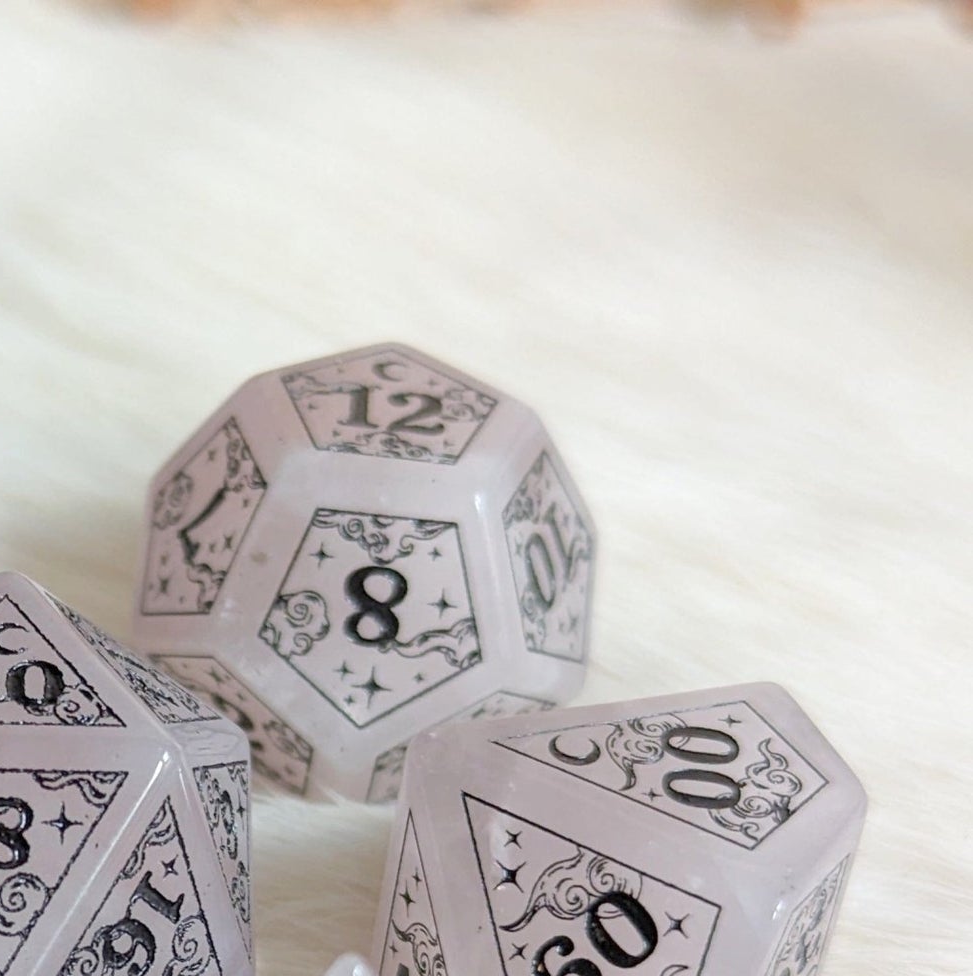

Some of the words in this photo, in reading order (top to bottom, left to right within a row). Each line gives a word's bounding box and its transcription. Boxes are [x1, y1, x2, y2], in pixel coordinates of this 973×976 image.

[338, 384, 444, 435] 12
[343, 566, 408, 647] 8
[661, 726, 742, 810] 00
